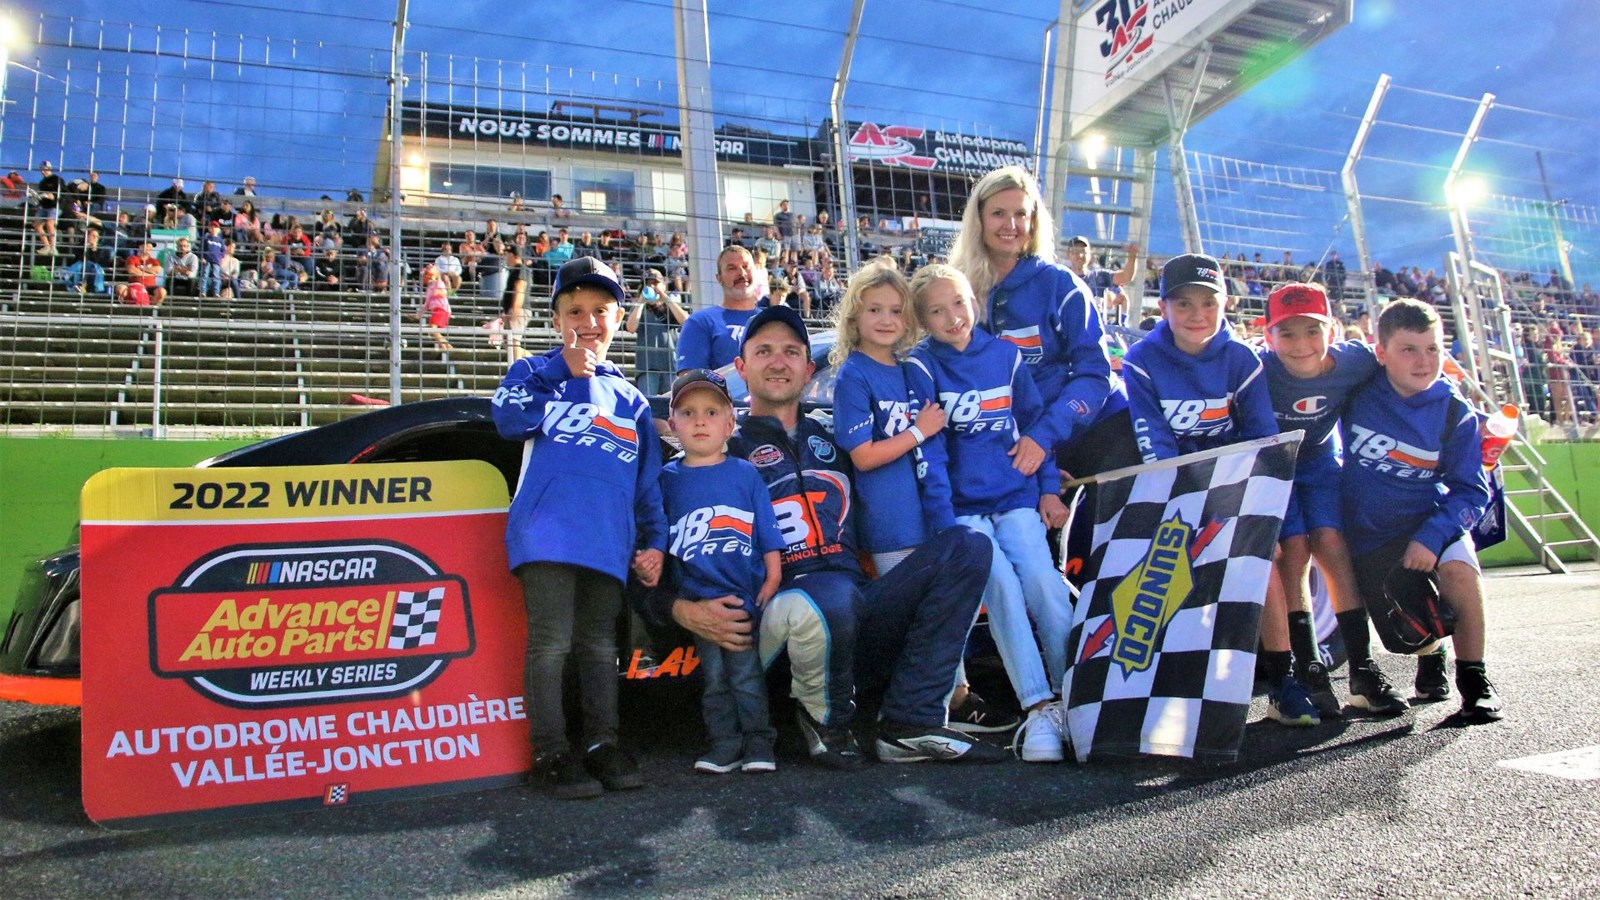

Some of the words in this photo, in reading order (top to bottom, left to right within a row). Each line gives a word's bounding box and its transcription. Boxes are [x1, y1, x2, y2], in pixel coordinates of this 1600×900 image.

[459, 117, 531, 138] NOUS
[537, 125, 641, 147] SOMMES
[934, 130, 1027, 153] Autodrome
[541, 401, 600, 436] 78
[939, 389, 981, 428] 78
[1159, 399, 1207, 431] 78
[954, 419, 1011, 434] CRE
[1350, 423, 1397, 460] 78
[553, 434, 638, 464] CREW
[1358, 457, 1435, 479] CREW
[169, 482, 271, 510] 2022
[284, 476, 433, 508] WINNER
[669, 506, 715, 558] 78
[683, 540, 753, 562] CREW
[279, 557, 377, 583] NASCAR
[1116, 526, 1186, 665] SUNOCO
[201, 599, 380, 633] Advance
[178, 632, 277, 662] Auto
[280, 626, 375, 657] Parts
[250, 668, 330, 691] WEEKLY
[330, 663, 397, 685] SERIES
[106, 714, 339, 758] AUTODROME
[347, 694, 527, 732] CHAUDIÈRE
[170, 733, 480, 788] VALLÉE-JONCTION
